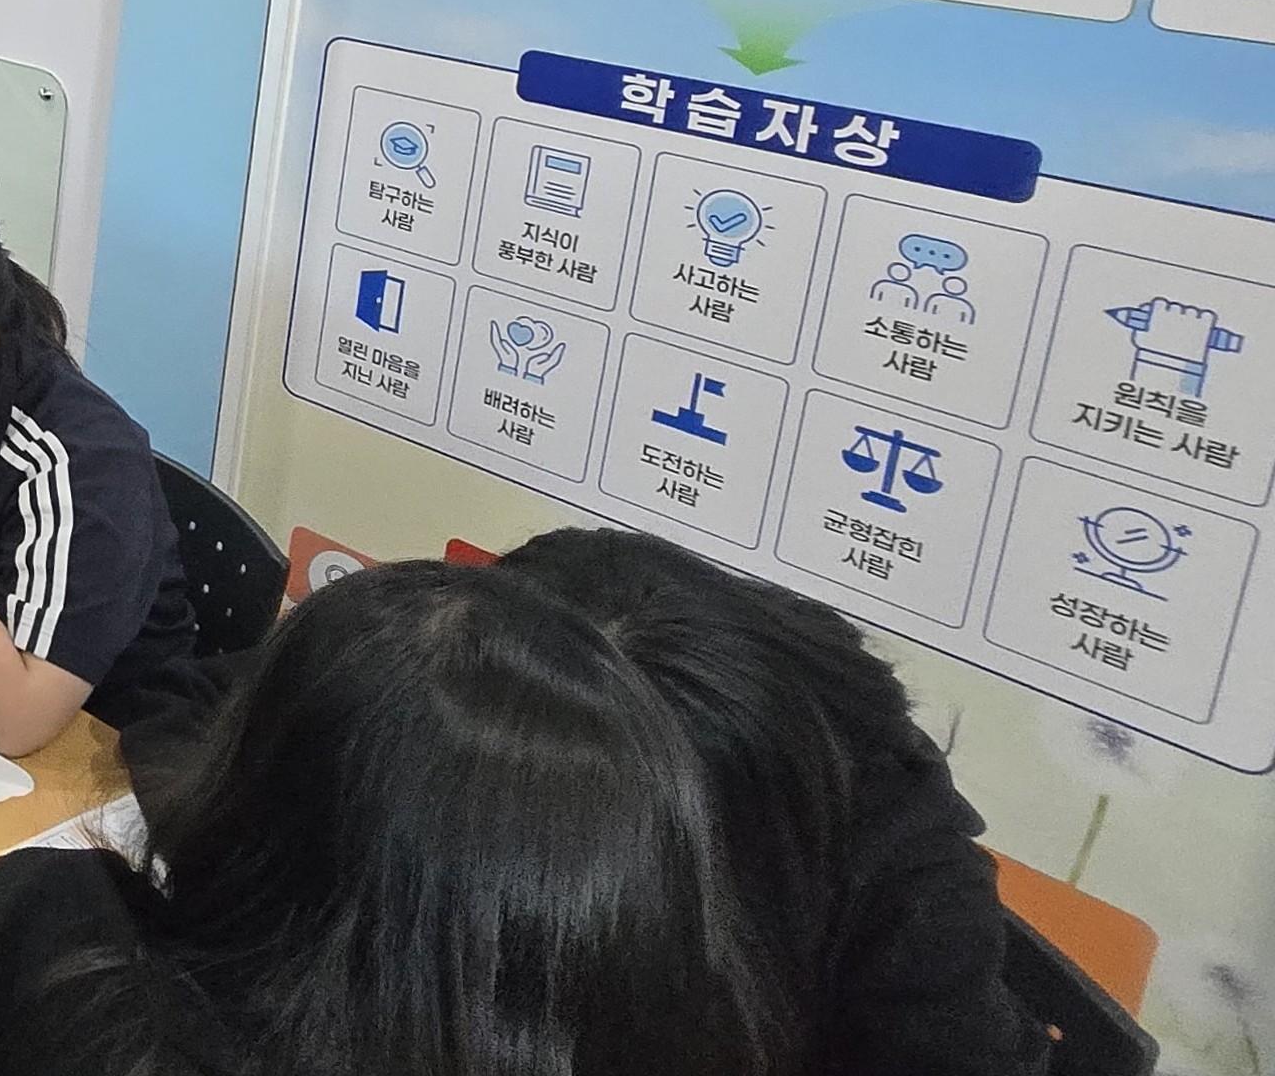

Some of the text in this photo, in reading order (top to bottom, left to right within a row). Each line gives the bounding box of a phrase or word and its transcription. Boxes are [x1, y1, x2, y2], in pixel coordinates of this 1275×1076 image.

[619, 73, 901, 167] 학습자상
[368, 180, 434, 214] 탐구하는
[381, 208, 415, 232] 사람
[523, 221, 579, 253] 지식이
[497, 241, 597, 284] 풍부한 사람
[673, 263, 760, 303] 사고하는
[689, 294, 735, 324] 사람
[337, 335, 421, 380] 열린 마음을
[863, 316, 968, 361] 소통하는
[342, 361, 410, 399] 지닌 사람
[883, 350, 937, 383] 사람
[483, 388, 556, 429] 배려하는
[1113, 380, 1208, 425] 원칙을
[497, 420, 535, 446] 사람
[1072, 401, 1240, 470] 지키는 사람
[640, 443, 725, 490] 도전하는
[656, 478, 700, 508] 사람
[822, 508, 923, 565] 균형잡힌
[841, 546, 894, 581] 사람
[1049, 591, 1172, 653] 성장하는
[1070, 631, 1135, 671] 사람
